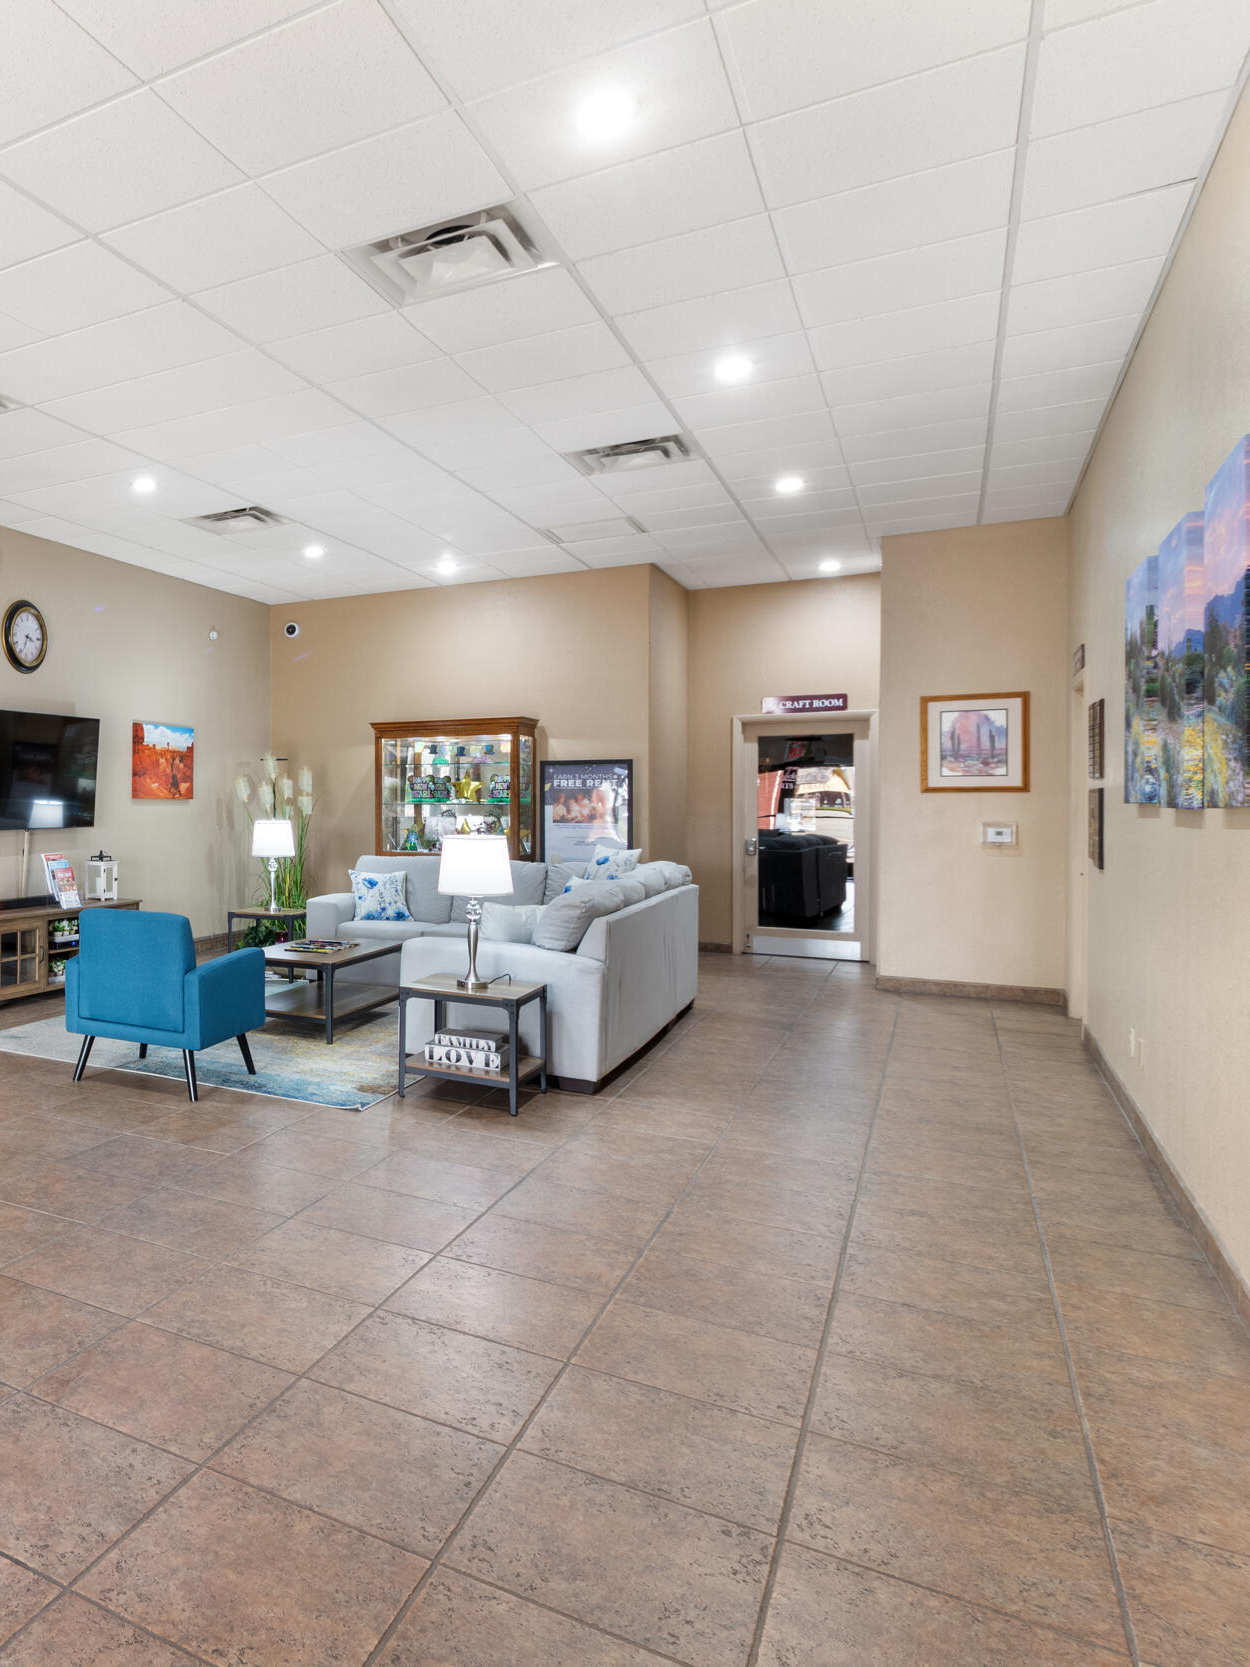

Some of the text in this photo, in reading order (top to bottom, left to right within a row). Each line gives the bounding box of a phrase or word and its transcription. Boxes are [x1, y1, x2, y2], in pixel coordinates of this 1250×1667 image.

[780, 698, 844, 709] CRAFT ROOM
[553, 779, 583, 787] FREE
[437, 1034, 492, 1051] FAMILY
[428, 1046, 500, 1069] LOVE
